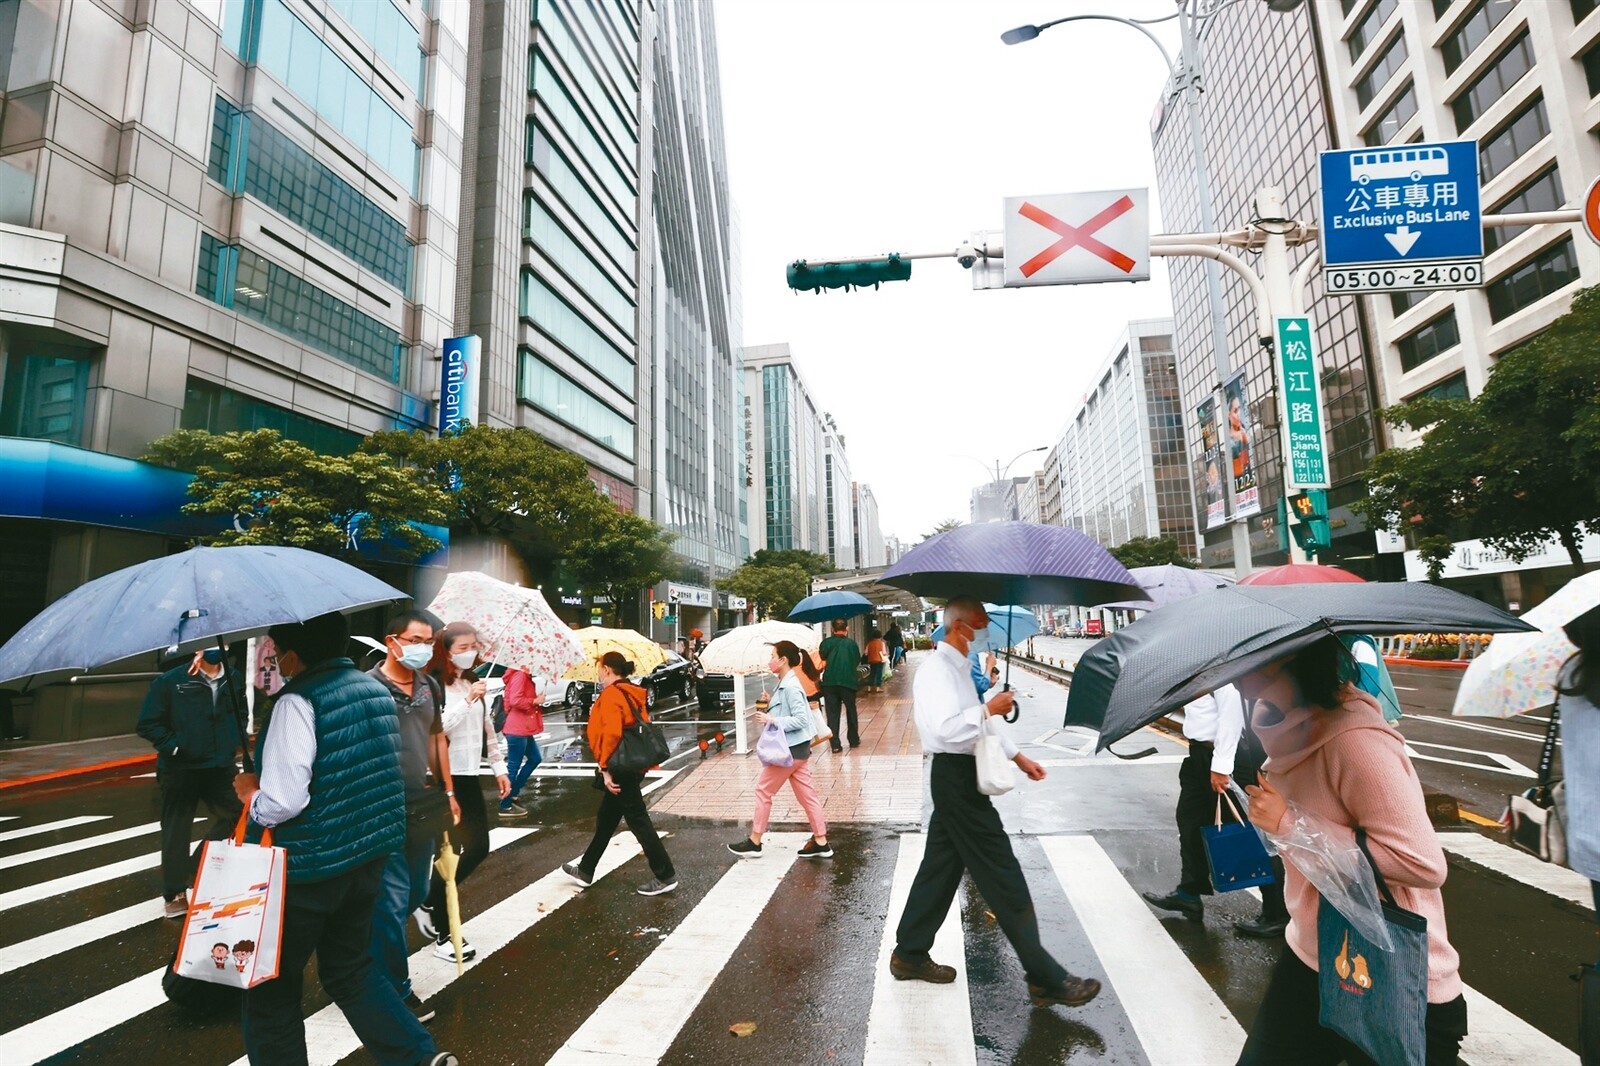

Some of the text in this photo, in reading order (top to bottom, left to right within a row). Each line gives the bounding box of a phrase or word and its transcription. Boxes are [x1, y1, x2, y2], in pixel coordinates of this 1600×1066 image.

[1345, 182, 1459, 212] 公車專用
[1333, 209, 1470, 229] Exclusive Bus Lane
[1285, 340, 1313, 423] 松江路
[445, 350, 465, 432] citibank
[1291, 432, 1317, 443] Song
[1292, 441, 1320, 452] Jiang
[1292, 450, 1309, 459] Rd.
[1294, 459, 1321, 468] 156 131
[1296, 473, 1323, 482] 122 119
